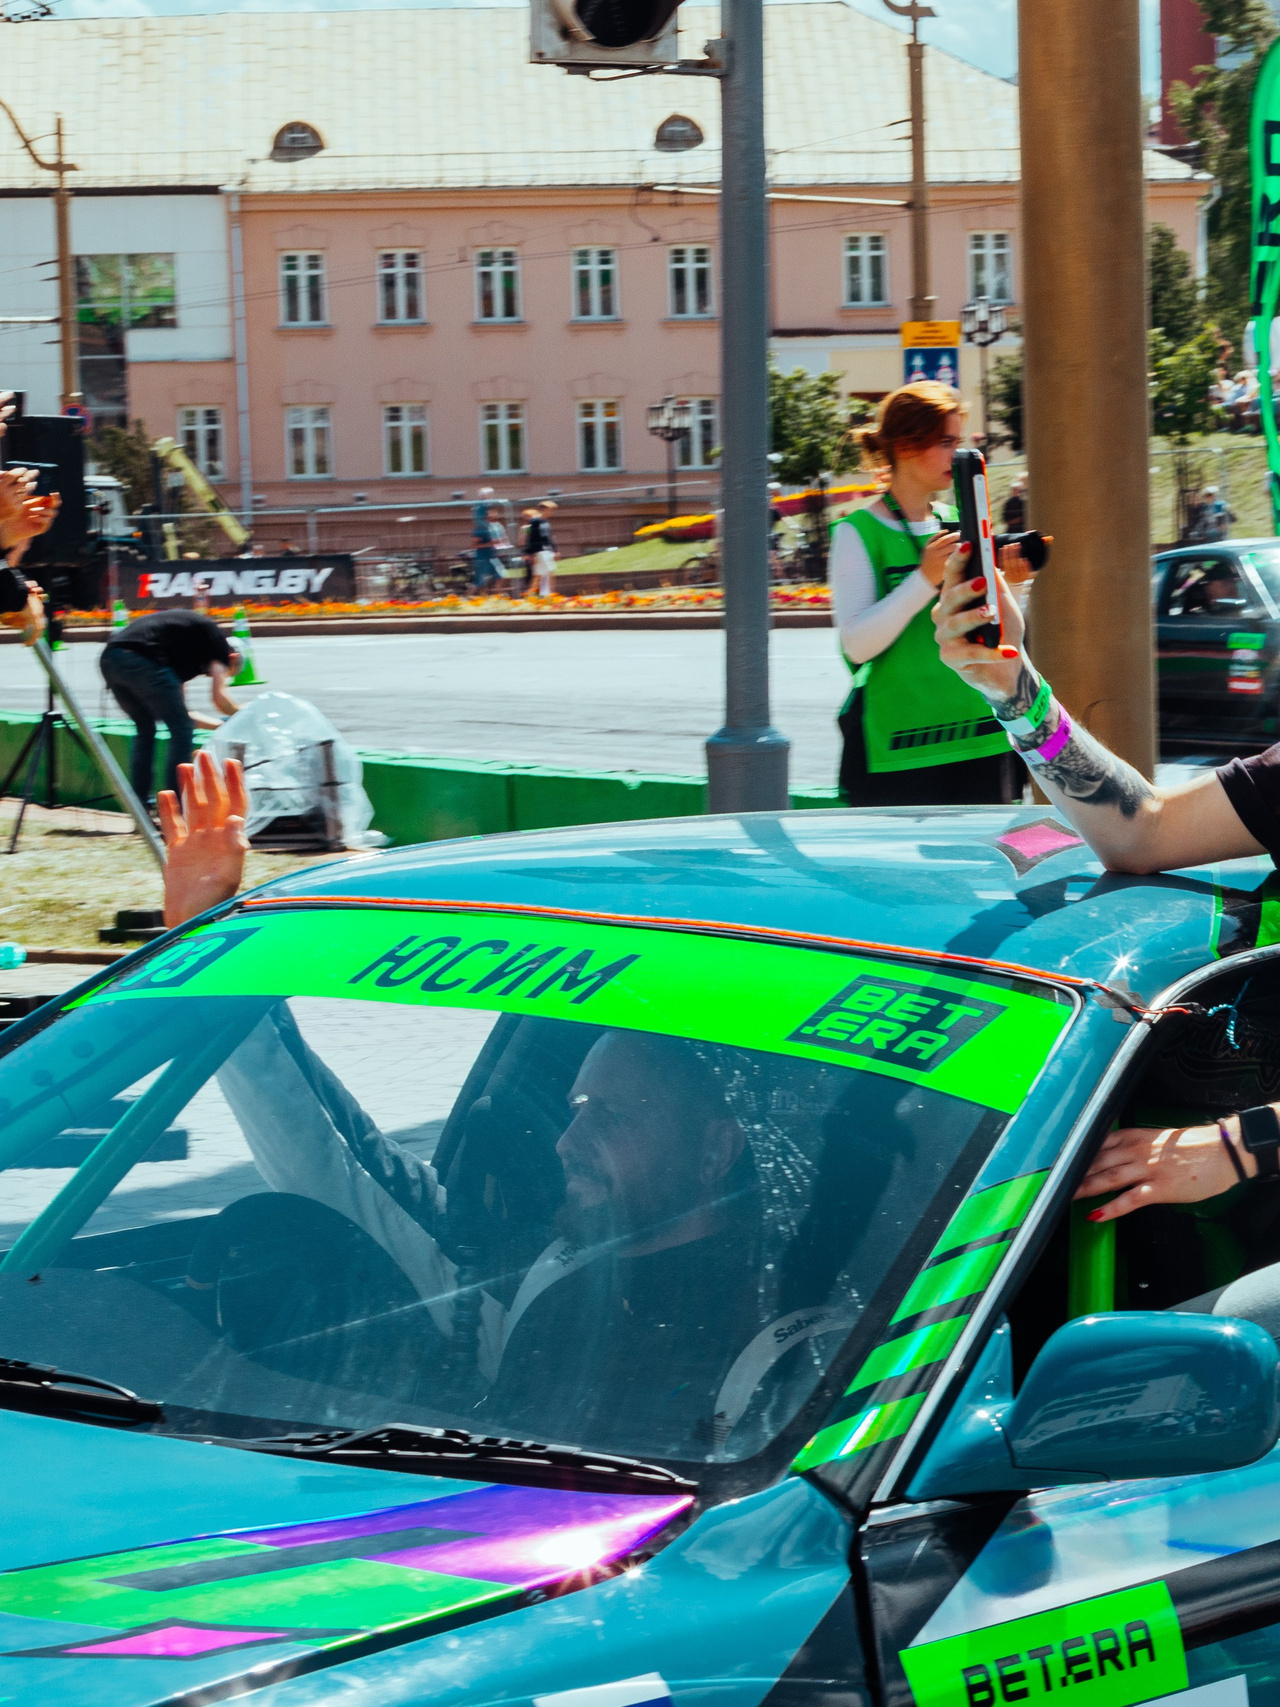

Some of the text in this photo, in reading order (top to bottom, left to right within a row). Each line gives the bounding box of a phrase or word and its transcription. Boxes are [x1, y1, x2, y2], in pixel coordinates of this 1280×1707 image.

[120, 936, 227, 987] 93
[346, 935, 643, 1005] ЮСИМ
[839, 983, 985, 1031] BET
